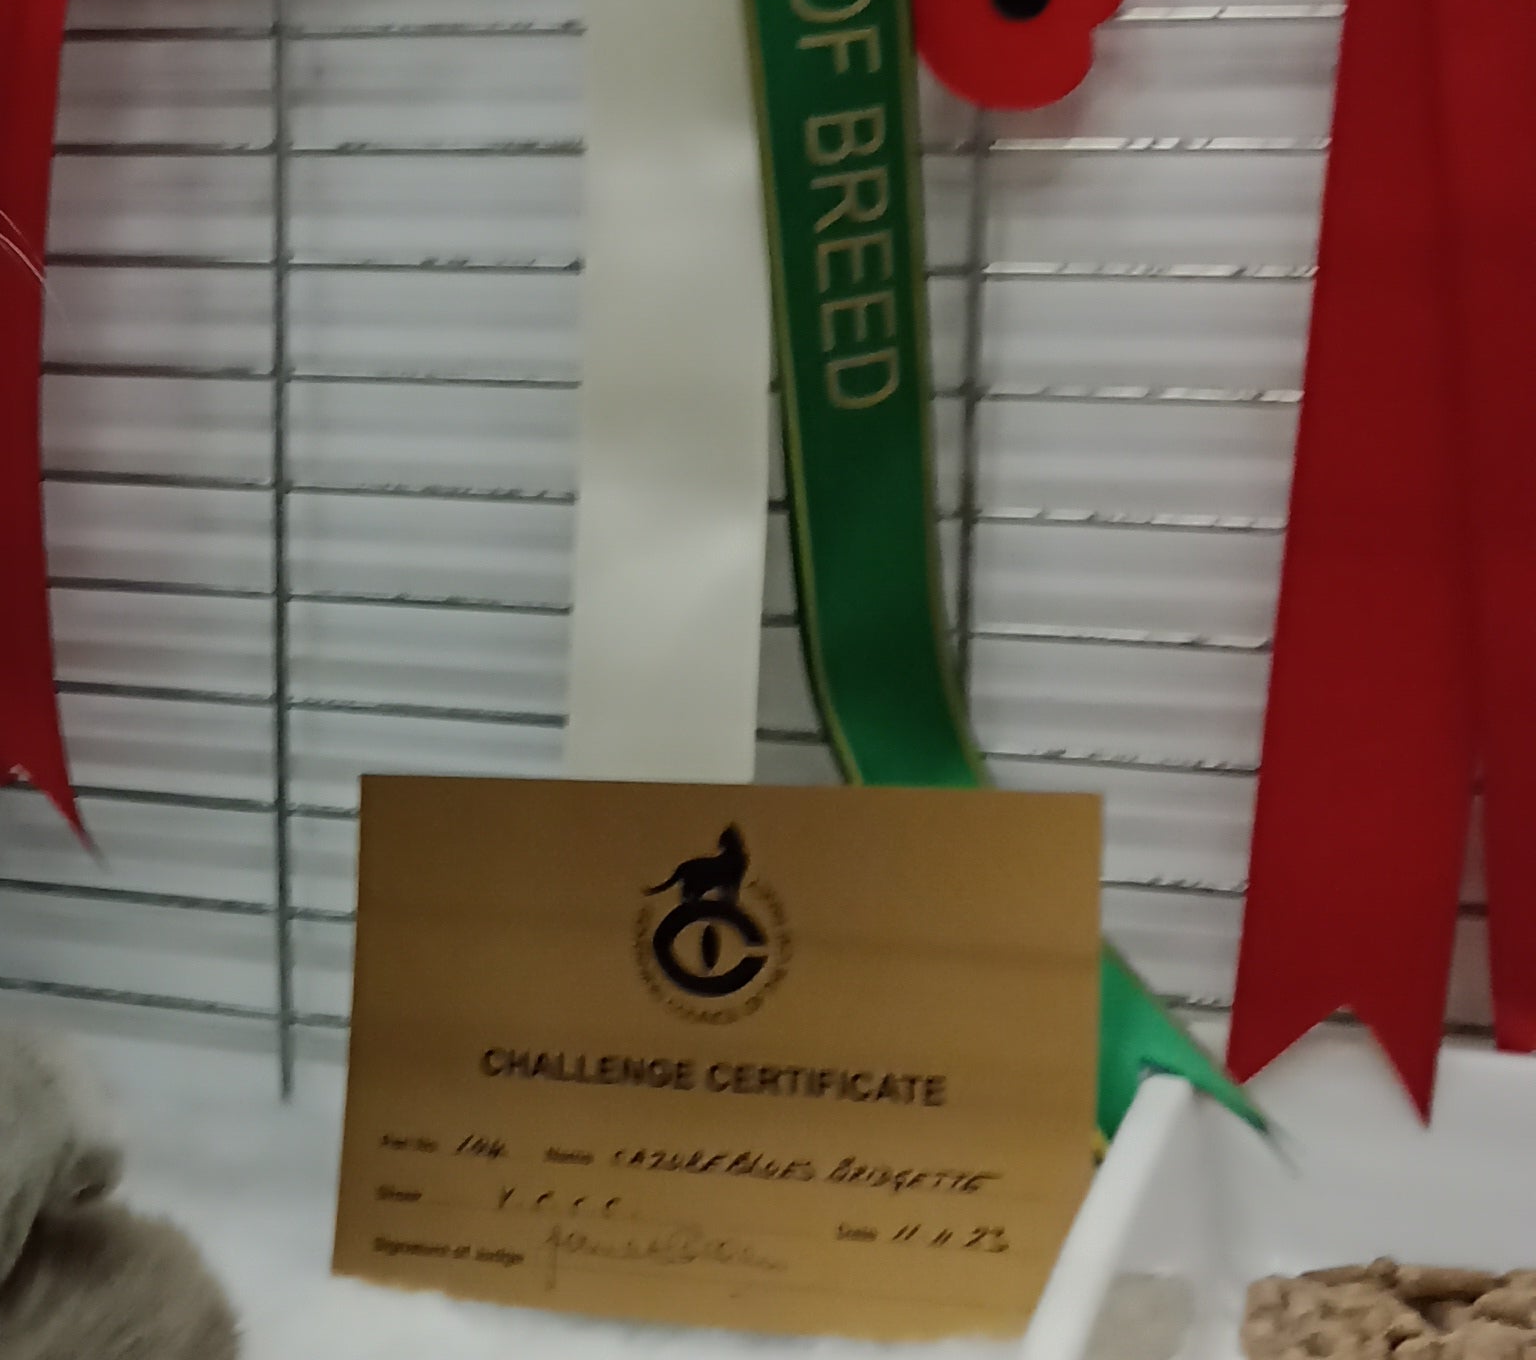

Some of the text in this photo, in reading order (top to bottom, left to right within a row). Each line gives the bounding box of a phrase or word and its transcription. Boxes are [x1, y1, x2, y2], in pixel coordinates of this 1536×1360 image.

[803, 106, 901, 410] BREED
[480, 1045, 948, 1107] CHALLENGE CERTIFICATE
